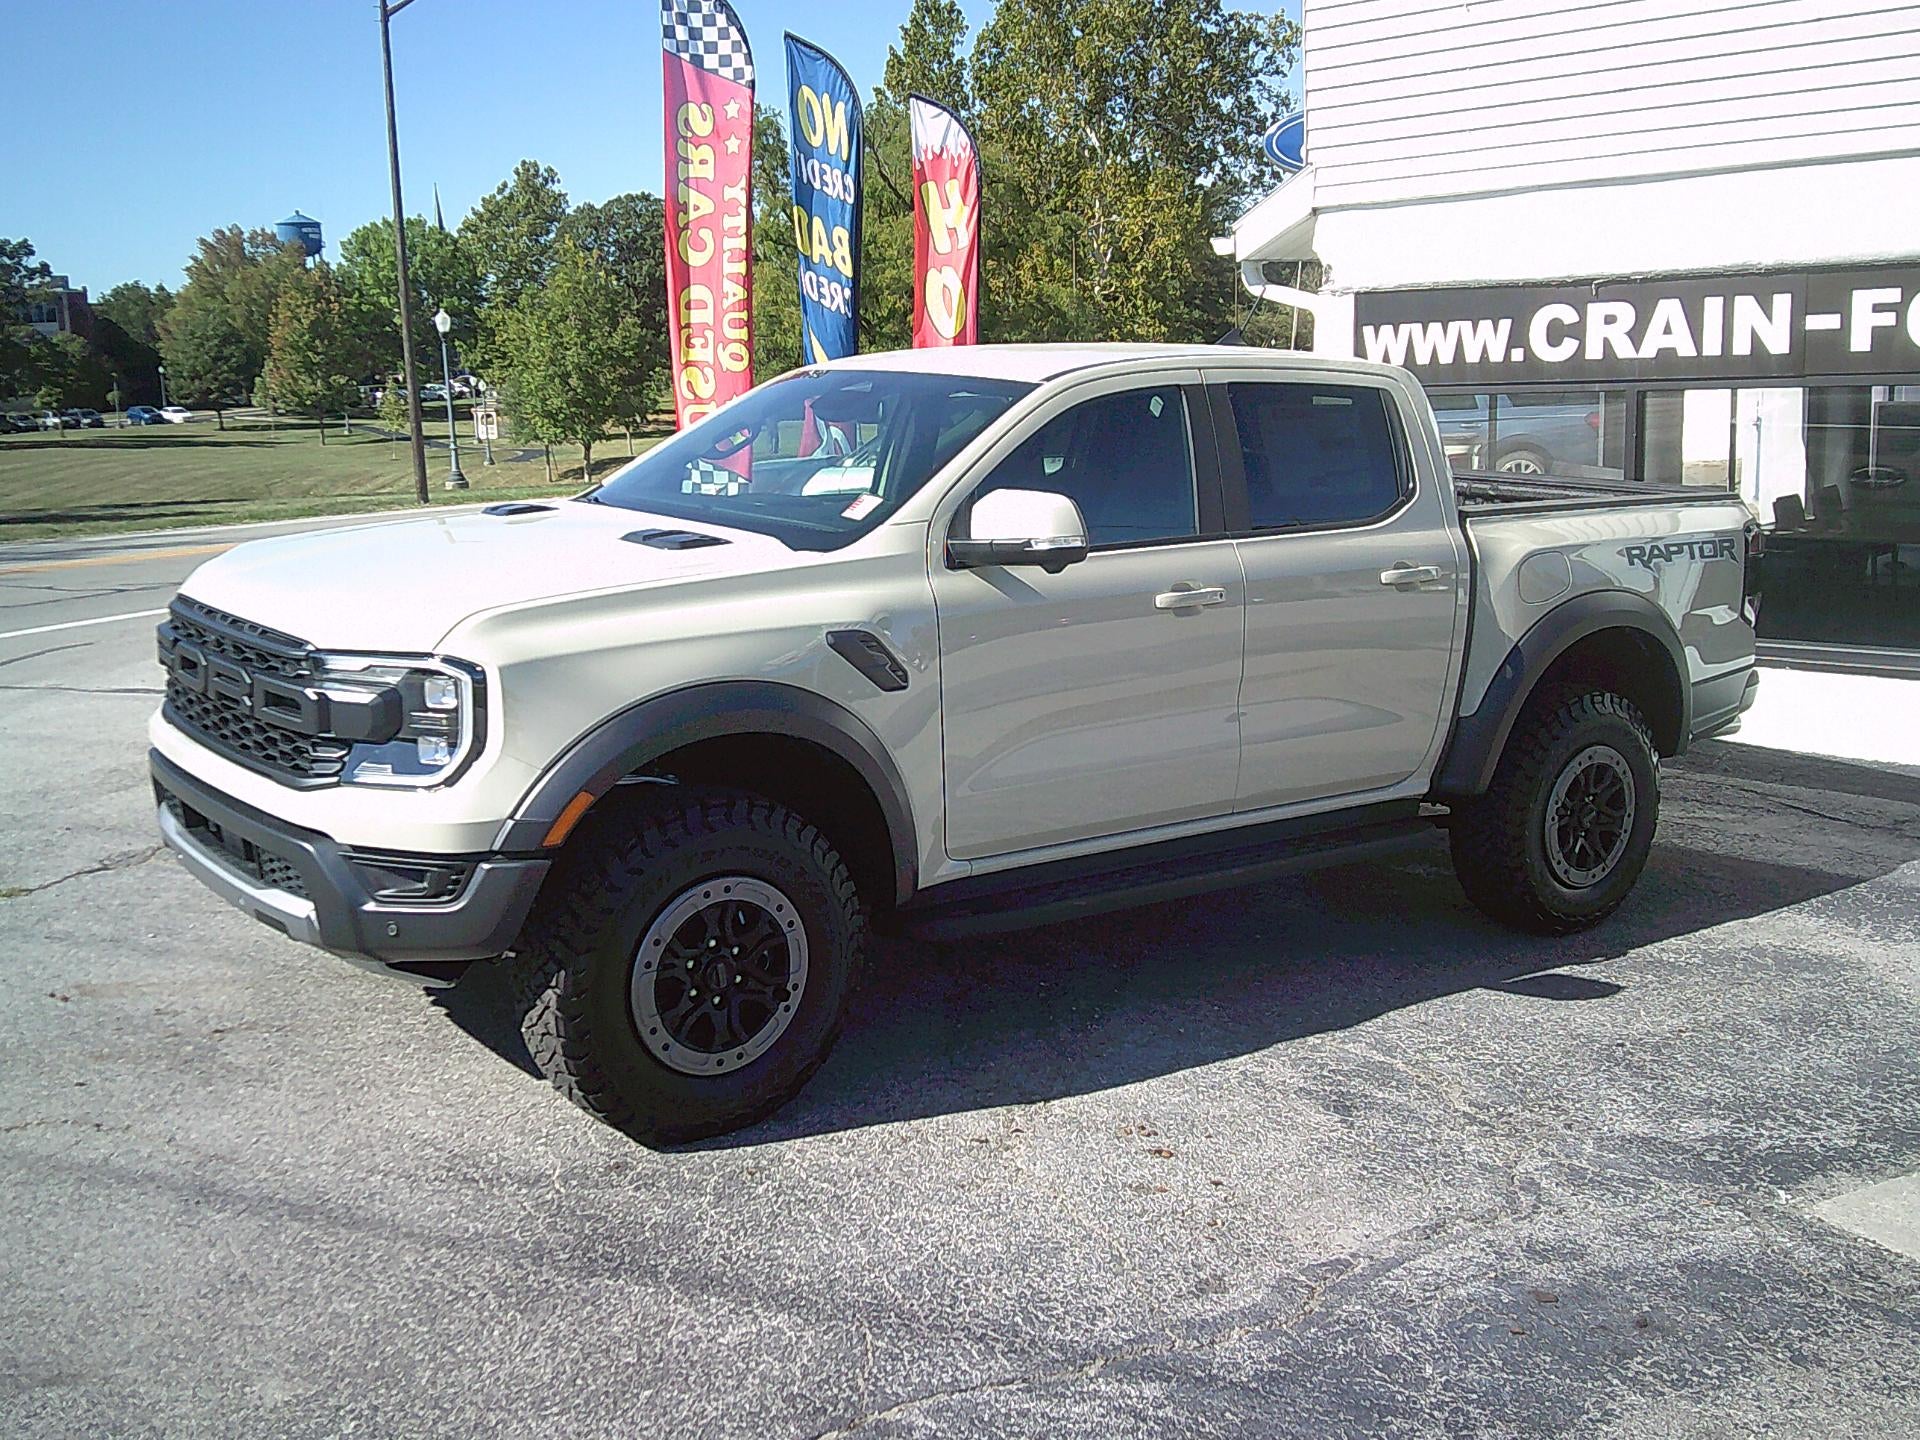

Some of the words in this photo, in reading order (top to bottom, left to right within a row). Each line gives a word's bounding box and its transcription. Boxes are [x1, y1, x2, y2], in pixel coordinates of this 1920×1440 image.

[1362, 286, 1920, 365] www.CRAIN-F
[1624, 537, 1739, 574] RAPTOR
[158, 627, 320, 735] ORD
